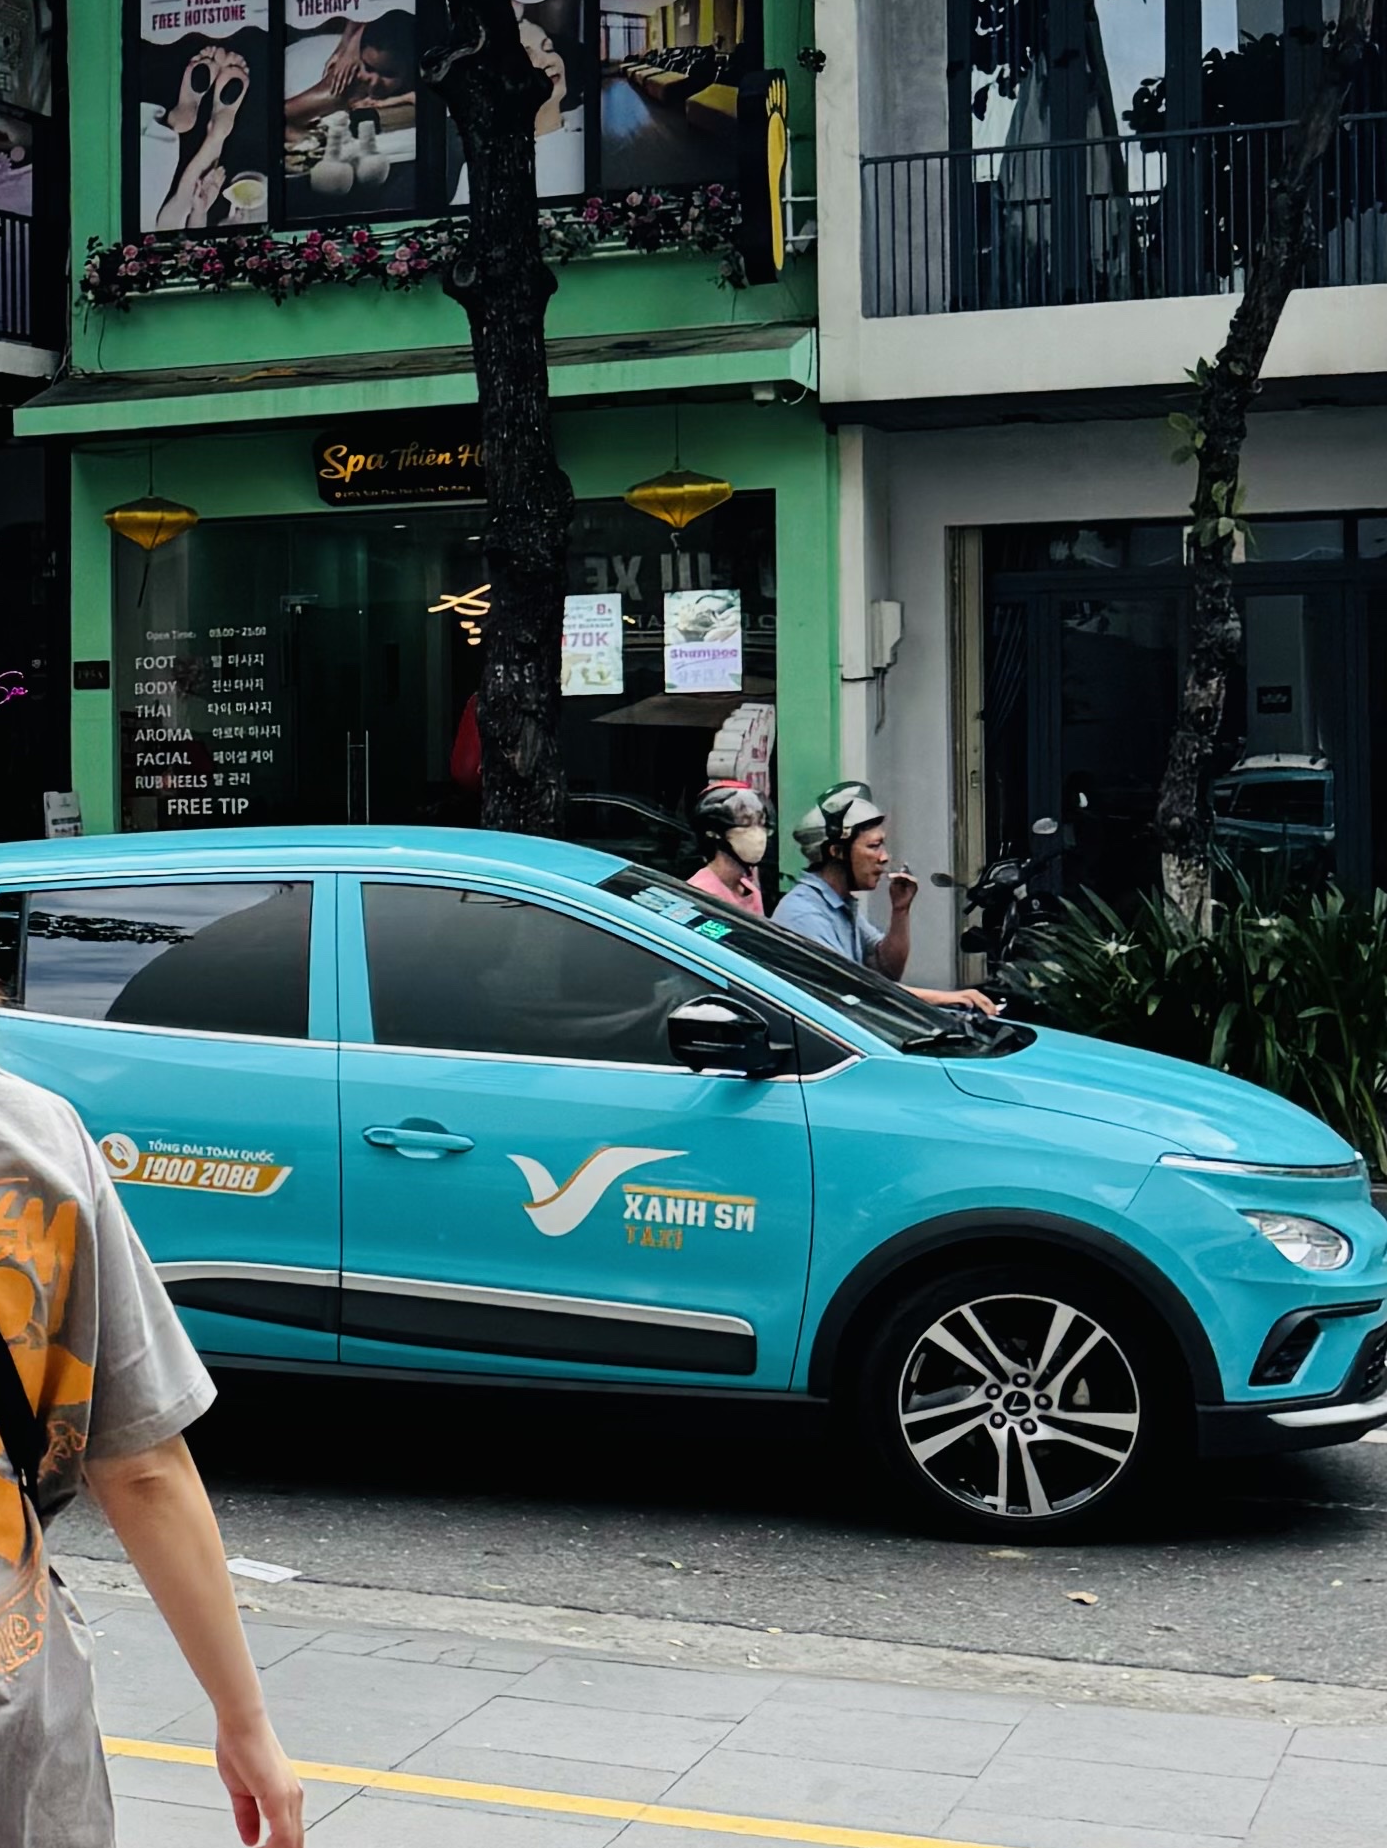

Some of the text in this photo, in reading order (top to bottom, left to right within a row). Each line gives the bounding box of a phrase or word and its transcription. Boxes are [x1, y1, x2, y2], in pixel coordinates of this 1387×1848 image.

[152, 5, 246, 31] FREE HOTSTONE
[319, 444, 390, 483] Spa
[135, 655, 177, 670] FOOT
[228, 653, 265, 668] 마사지
[134, 680, 178, 696] BODY
[135, 703, 171, 718] THAI
[235, 701, 272, 715] 마사지
[134, 728, 193, 743] AROMA
[248, 725, 282, 739] 마사지
[136, 752, 192, 767] FACIAL
[135, 773, 207, 790] RUB HEELS
[167, 797, 250, 816] FREE TIP
[142, 1155, 261, 1192] 1900 2088
[623, 1193, 756, 1234] XANH SM
[624, 1224, 684, 1251] TAXI
